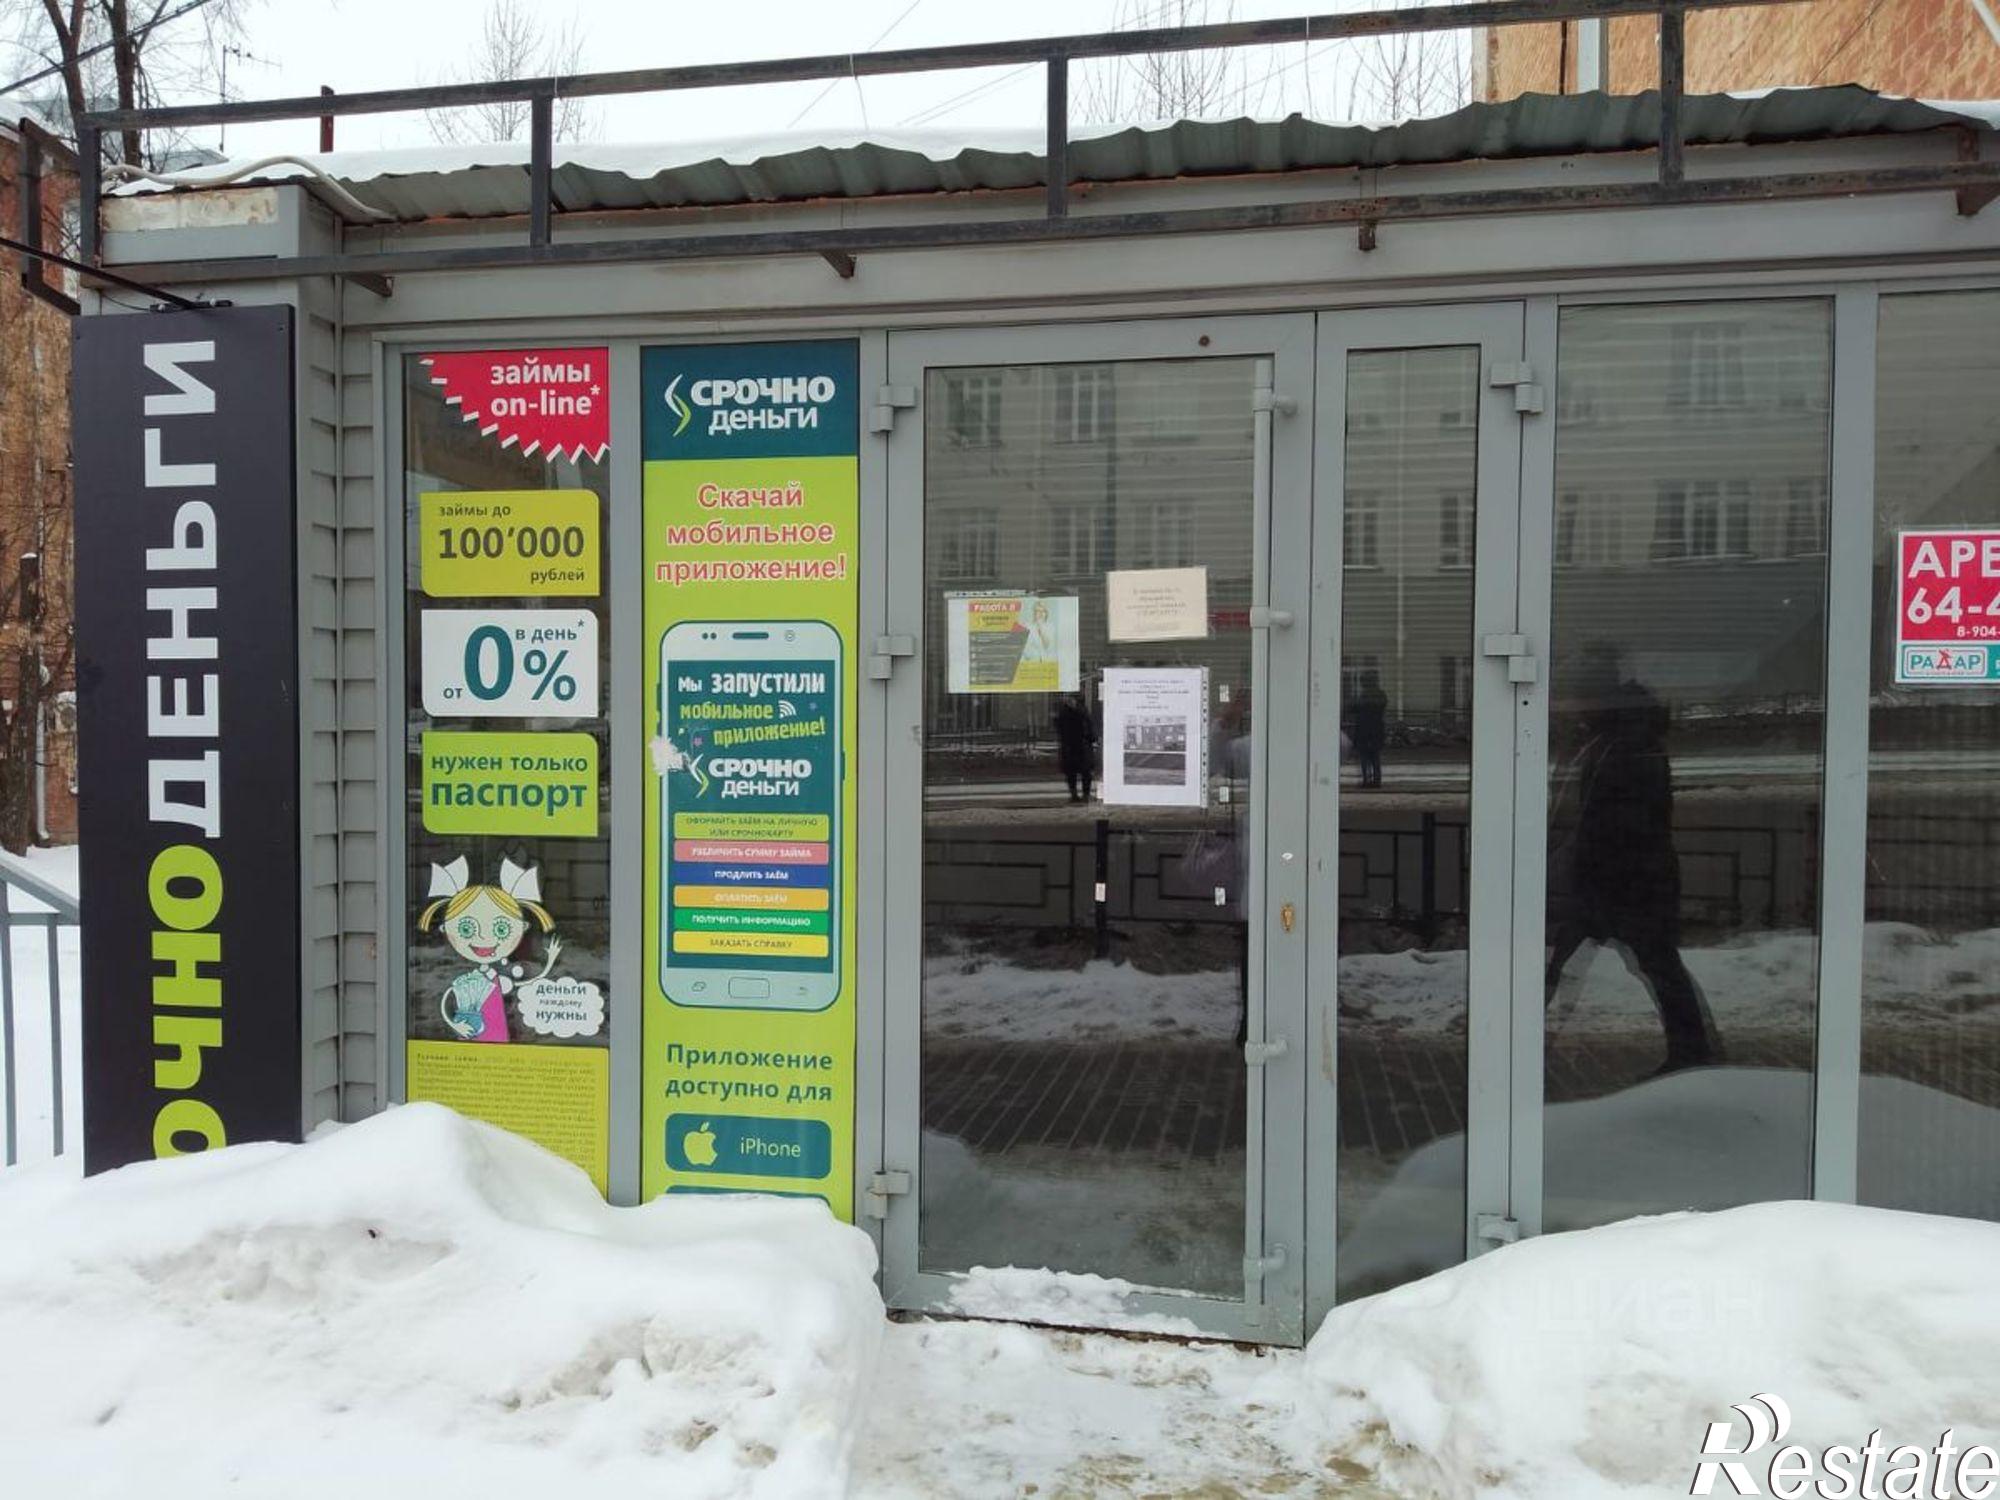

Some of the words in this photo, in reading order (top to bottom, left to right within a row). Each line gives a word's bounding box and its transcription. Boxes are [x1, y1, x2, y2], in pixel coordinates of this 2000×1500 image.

[490, 357, 592, 385] займы
[690, 376, 836, 407] СРОЧНО
[708, 407, 818, 436] деньги
[698, 481, 805, 509] Скачай
[439, 505, 488, 517] займы
[491, 506, 512, 519] до
[667, 520, 835, 546] мобильное
[530, 568, 585, 585] рублей
[656, 554, 847, 587] приложение!
[515, 629, 526, 641] в
[1910, 648, 1981, 671] РАДАР
[443, 686, 463, 700] от
[677, 676, 702, 693] Мы
[711, 672, 826, 697] запустили
[680, 701, 774, 720] мобильное
[713, 717, 826, 748] приложение!
[431, 755, 503, 776] нужен
[510, 756, 588, 772] только
[708, 758, 812, 779] СРОЧНО
[721, 779, 799, 799] деньги
[431, 783, 588, 817] паспорт
[744, 847, 779, 858] СУММУ
[714, 870, 763, 881] ПРОДЛИТЬ
[692, 915, 740, 925] ПОЛУЧИТЬ
[740, 916, 811, 927] ИНФОРМАЦИЮ
[710, 938, 752, 948] ЗАКАЗАТЬ
[536, 984, 587, 996] деньги
[536, 1010, 588, 1024] нужны
[667, 1043, 833, 1070] Приложение
[665, 1079, 779, 1101] доступно
[786, 1084, 832, 1104] для
[740, 1136, 801, 1158] iPhone
